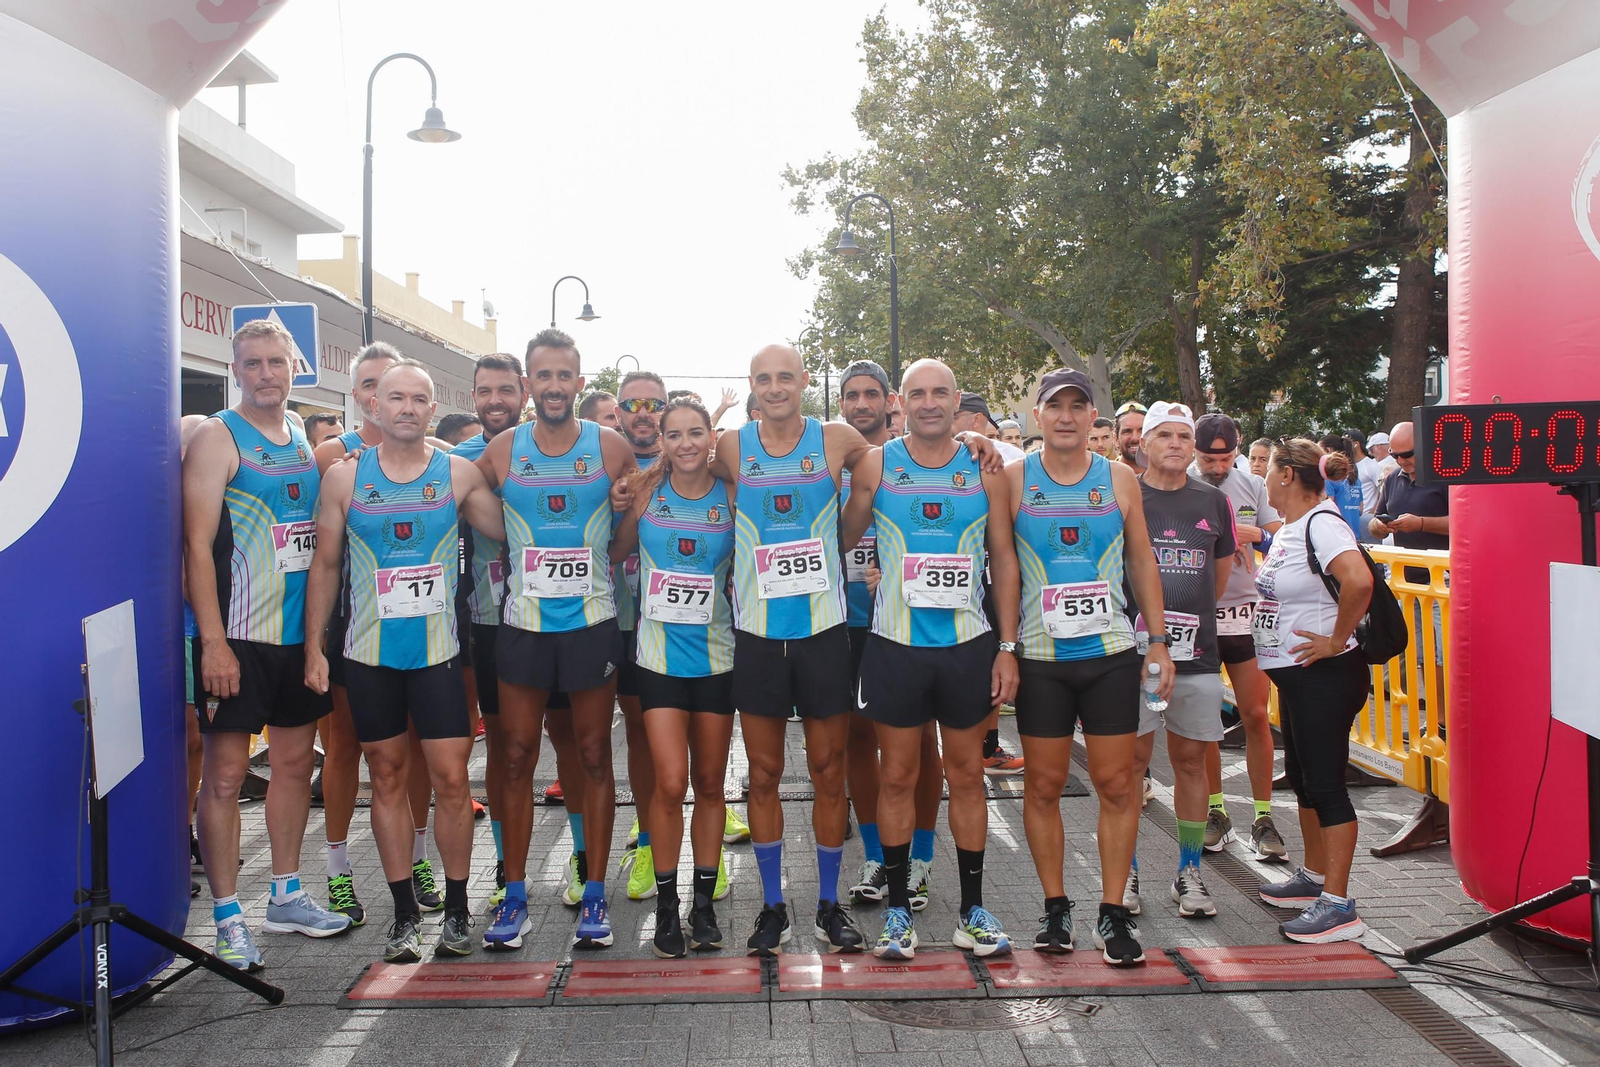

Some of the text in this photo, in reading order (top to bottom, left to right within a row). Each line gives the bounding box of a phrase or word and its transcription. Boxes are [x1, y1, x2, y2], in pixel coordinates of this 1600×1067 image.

[181, 291, 233, 340] CERV
[545, 562, 589, 578] 709
[777, 555, 823, 577] 395
[926, 571, 969, 588] 392
[408, 580, 435, 598] 17
[667, 587, 711, 606] 577
[1064, 597, 1108, 617] 531
[1216, 605, 1250, 620] 514
[1254, 614, 1275, 630] 315
[1165, 626, 1194, 642] 51
[1374, 756, 1384, 768] Los
[1384, 760, 1403, 776] Barrios
[97, 943, 108, 989] VONYX
